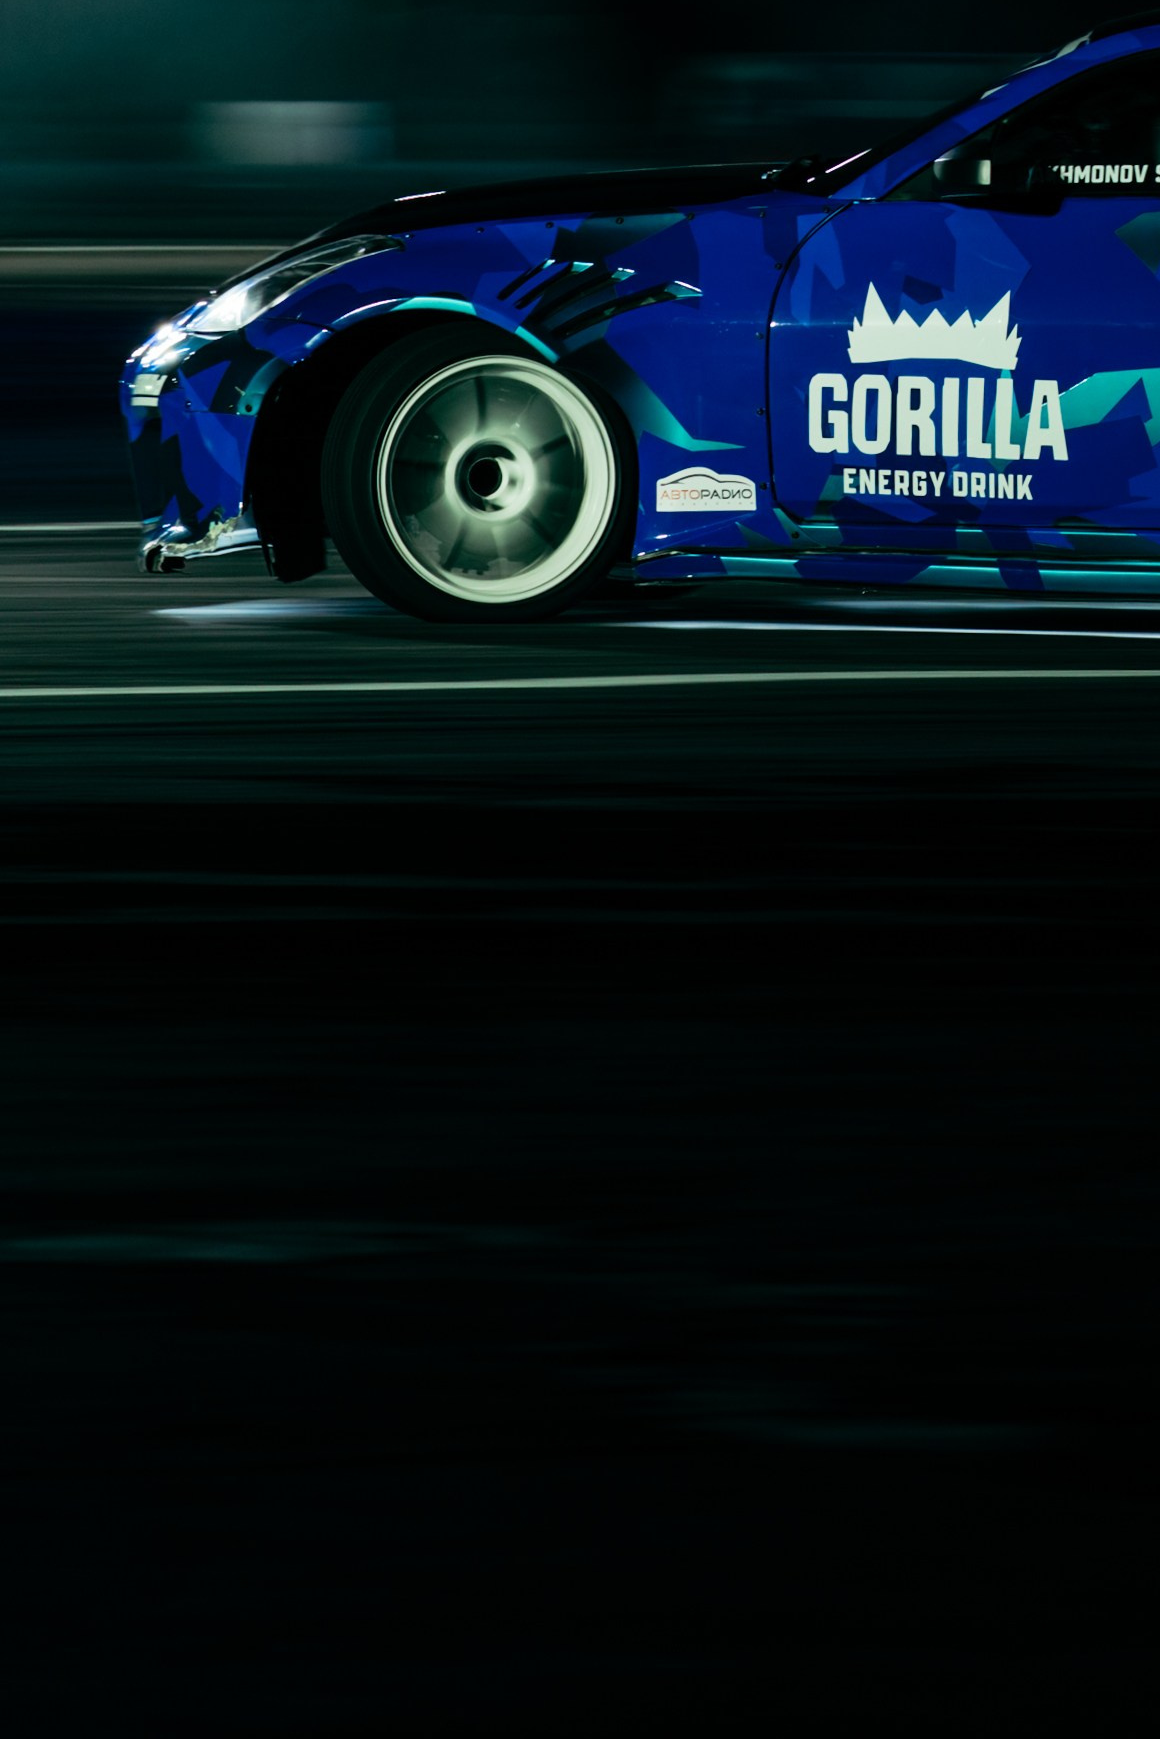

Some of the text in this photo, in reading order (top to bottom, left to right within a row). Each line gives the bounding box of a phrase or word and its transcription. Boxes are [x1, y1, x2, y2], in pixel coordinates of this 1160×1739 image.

[1048, 164, 1149, 184] HMONOV
[808, 372, 1069, 461] GORILLA
[843, 467, 1033, 501] ENERGY DRINK
